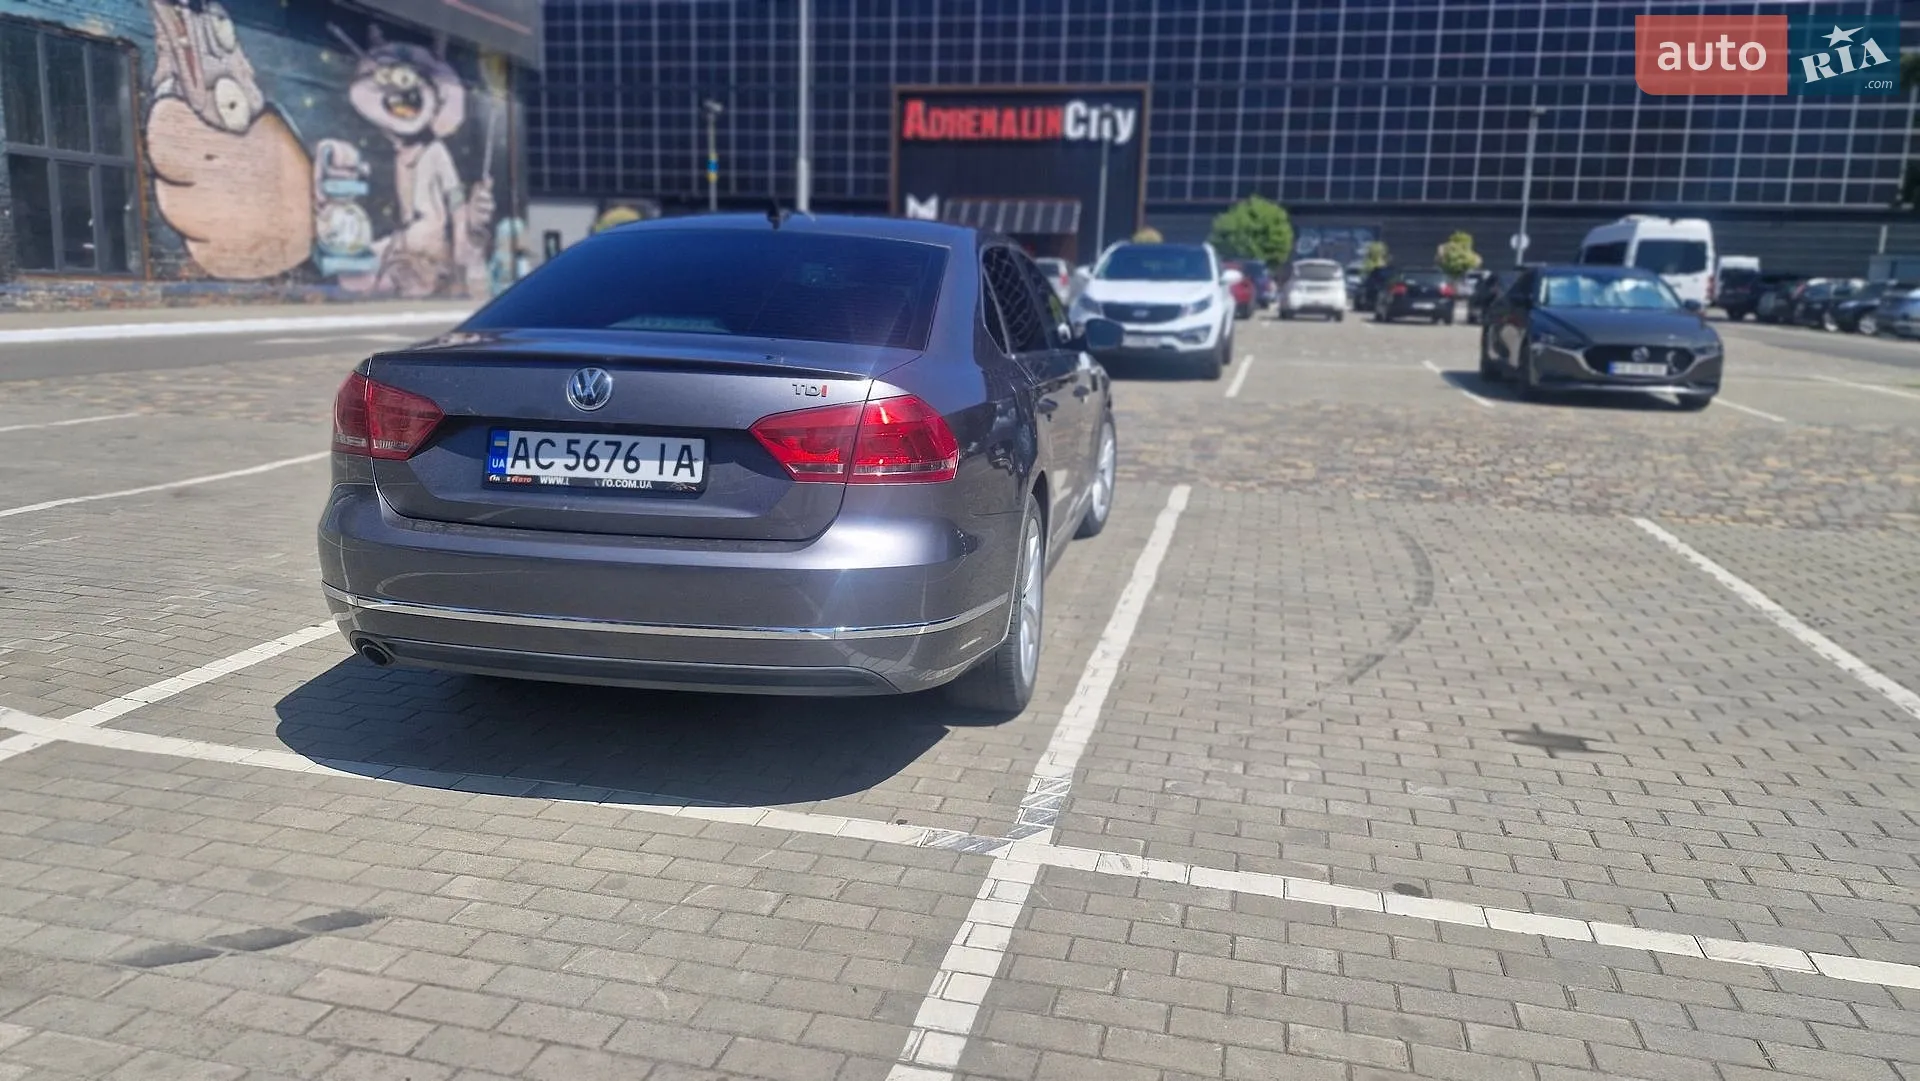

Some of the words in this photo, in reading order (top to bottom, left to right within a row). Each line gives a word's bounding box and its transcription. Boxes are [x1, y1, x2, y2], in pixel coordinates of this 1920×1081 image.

[792, 384, 828, 398] TDI
[491, 456, 505, 469] UA
[510, 437, 557, 471] AC
[564, 438, 641, 475] 5676
[658, 442, 696, 478] IA
